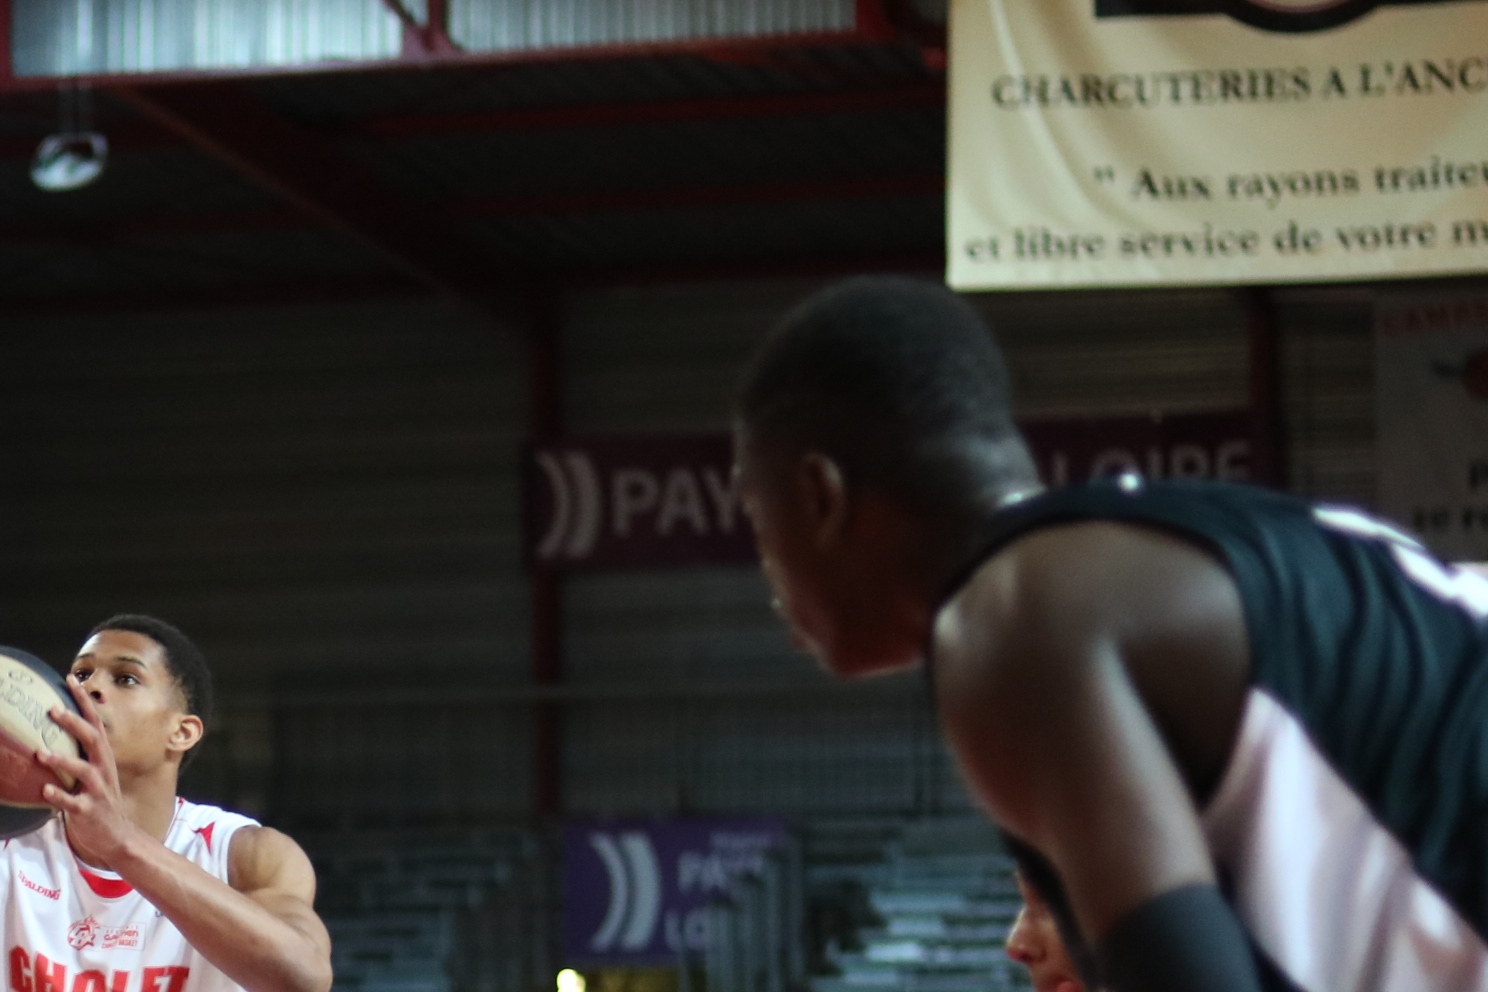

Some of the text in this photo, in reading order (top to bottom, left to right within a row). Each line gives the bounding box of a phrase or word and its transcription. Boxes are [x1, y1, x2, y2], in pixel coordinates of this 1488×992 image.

[991, 65, 1311, 111] CHARCUTERIES
[1322, 66, 1346, 99] A
[1131, 167, 1211, 198] Aux
[1226, 171, 1360, 209] rayons
[965, 236, 1000, 262] et
[1014, 226, 1105, 261] libre
[1119, 221, 1261, 259] service
[1273, 218, 1322, 254] de
[1336, 220, 1437, 249] votre
